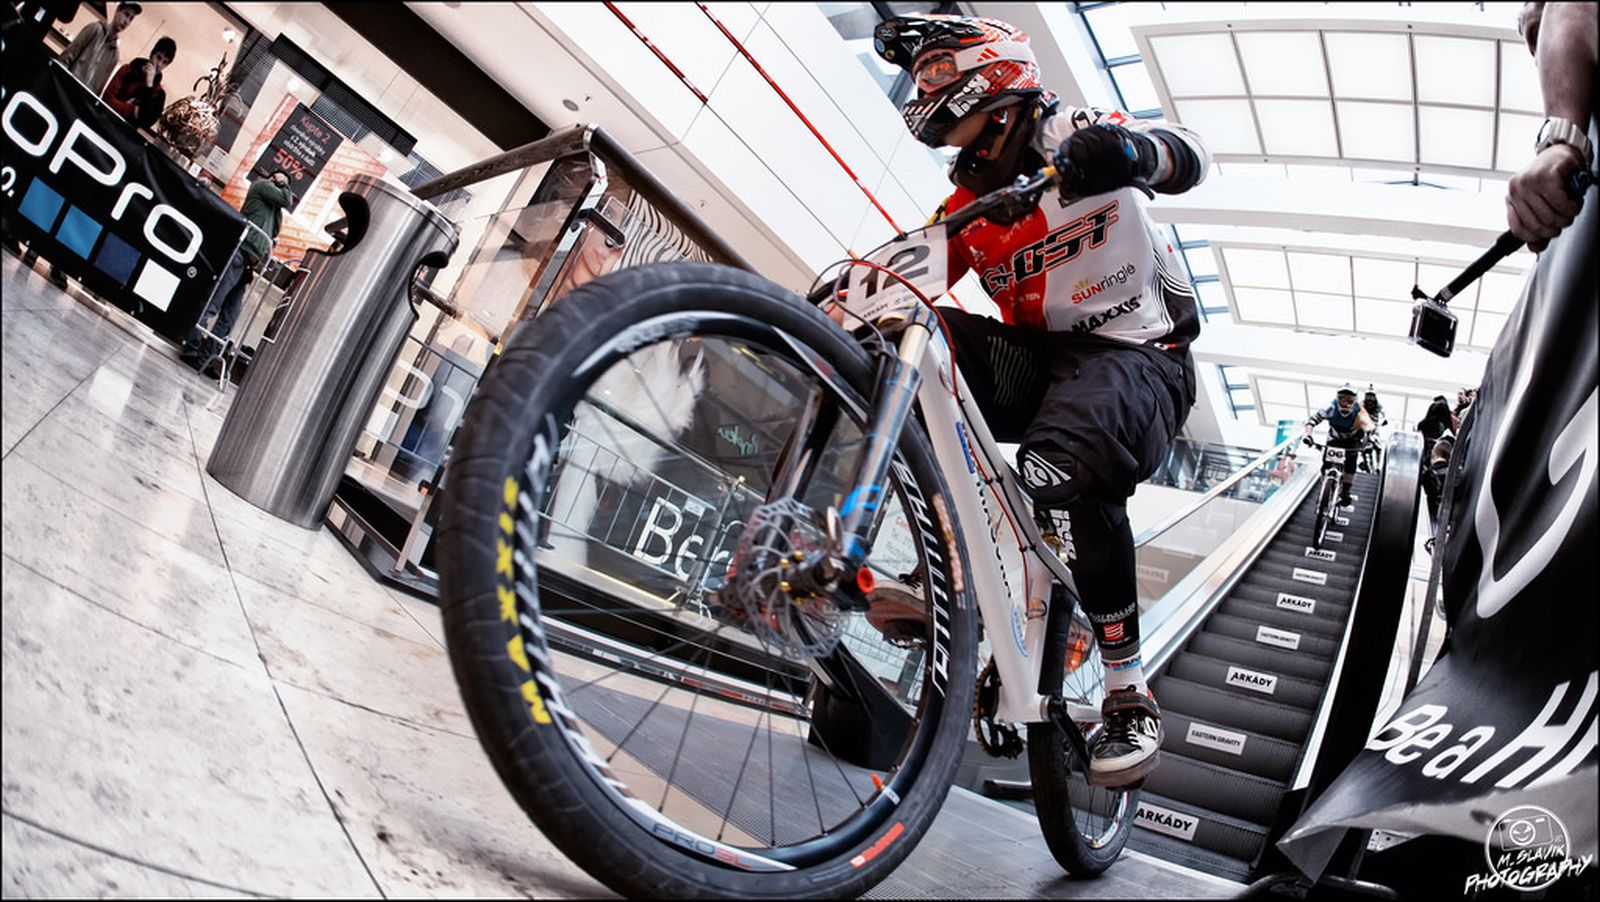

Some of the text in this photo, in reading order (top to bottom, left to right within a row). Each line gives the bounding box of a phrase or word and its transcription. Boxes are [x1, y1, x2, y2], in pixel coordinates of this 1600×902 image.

[2, 91, 203, 264] oPro
[273, 148, 305, 180] 50%
[859, 245, 930, 298] 12
[1072, 296, 1141, 335] MAXXIS
[496, 476, 552, 724] MAXXIS
[1230, 671, 1273, 687] ARKÁDY
[1191, 730, 1241, 746] EASTERN GRAVITY
[1365, 704, 1453, 764] Be
[1422, 726, 1496, 779] a
[1134, 808, 1193, 832] ARKÁDY
